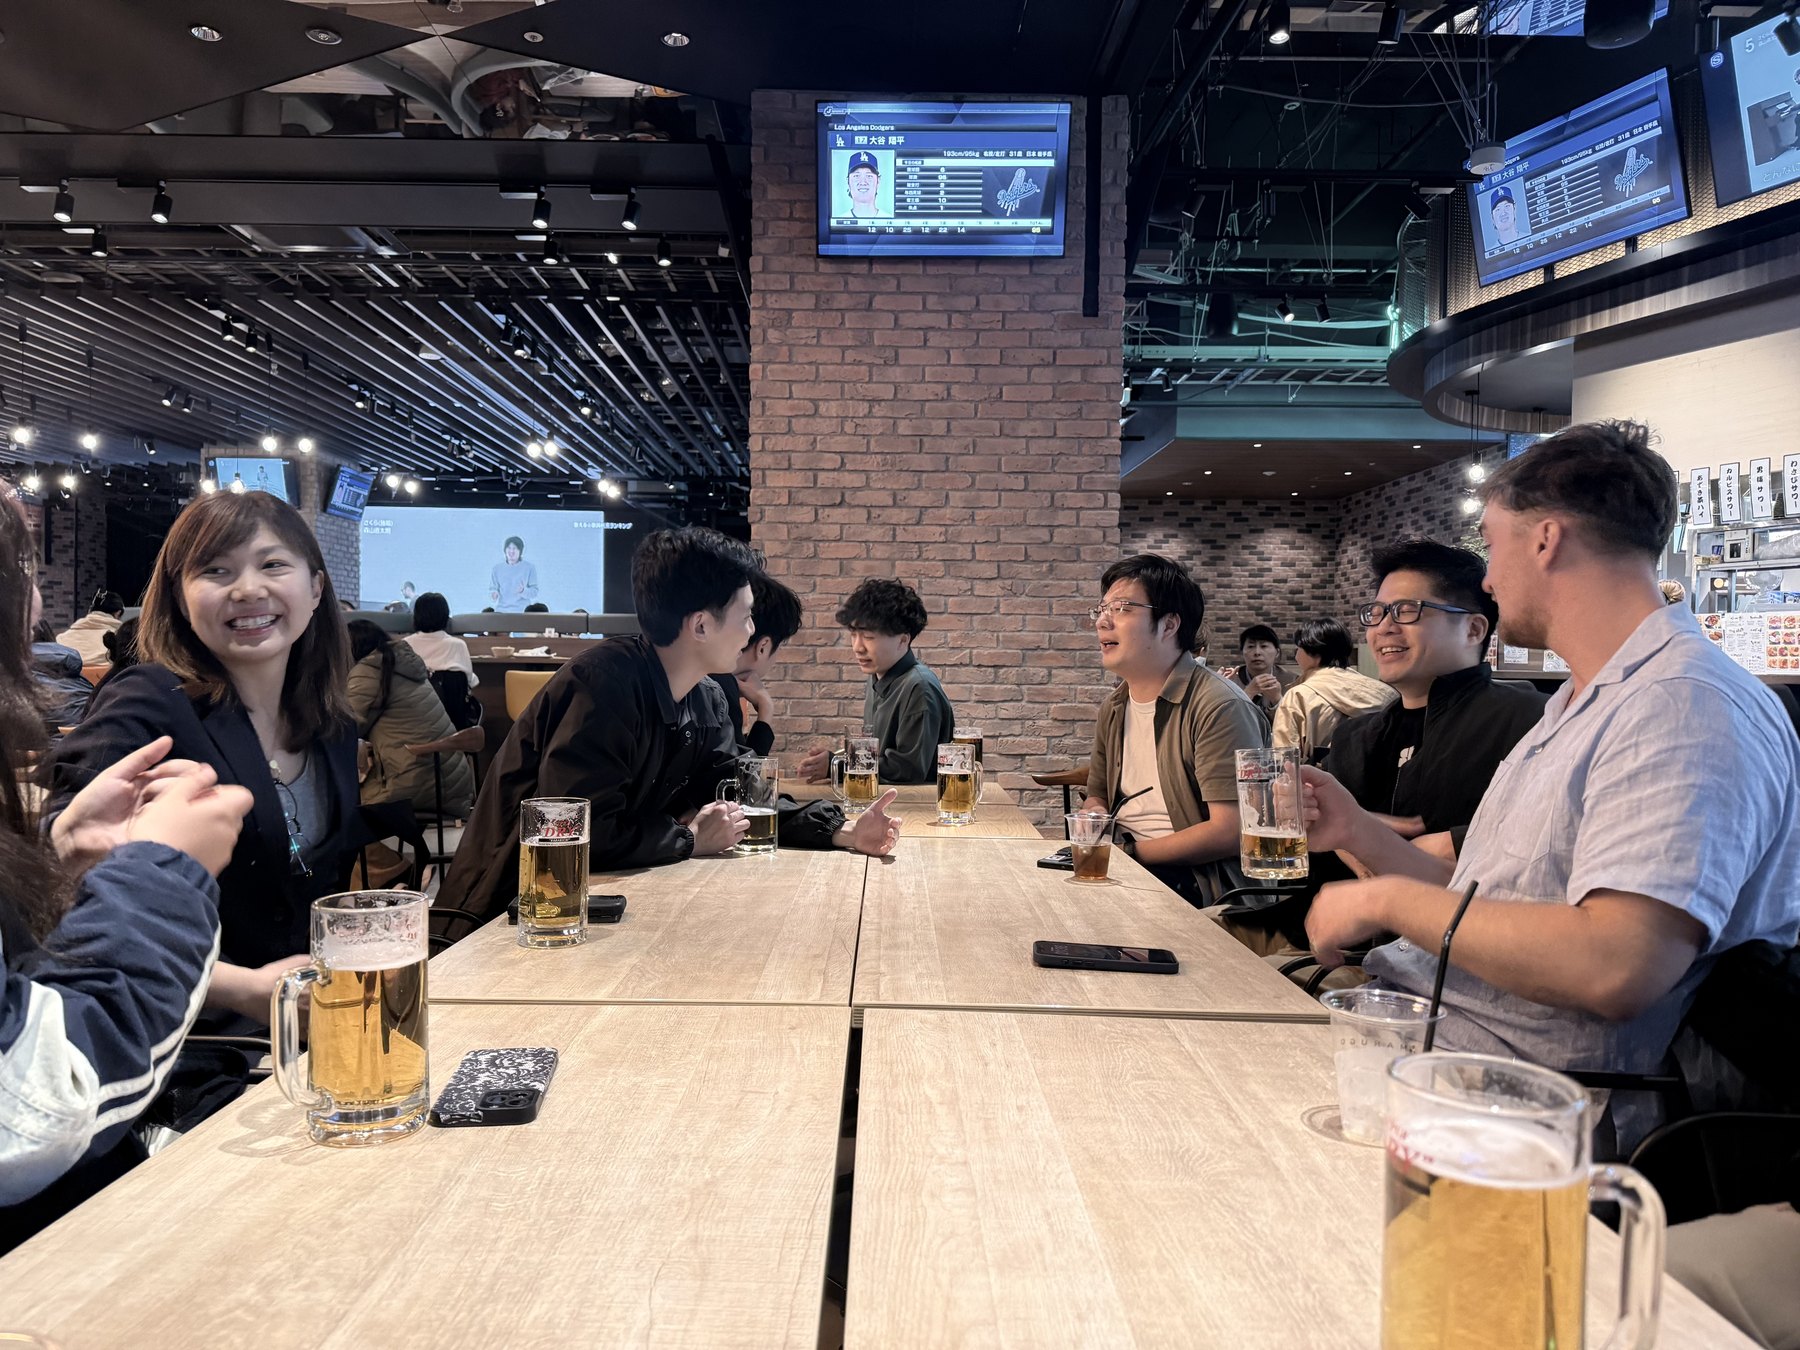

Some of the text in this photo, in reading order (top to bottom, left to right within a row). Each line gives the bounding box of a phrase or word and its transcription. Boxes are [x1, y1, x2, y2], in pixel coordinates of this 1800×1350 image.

[1745, 37, 1754, 53] 5
[1504, 156, 1520, 166] odgers
[997, 178, 1040, 206] Dodgers
[1584, 221, 1593, 229] 14
[1725, 467, 1734, 517] カルピスサワー
[1790, 460, 1799, 508] わさびサワー
